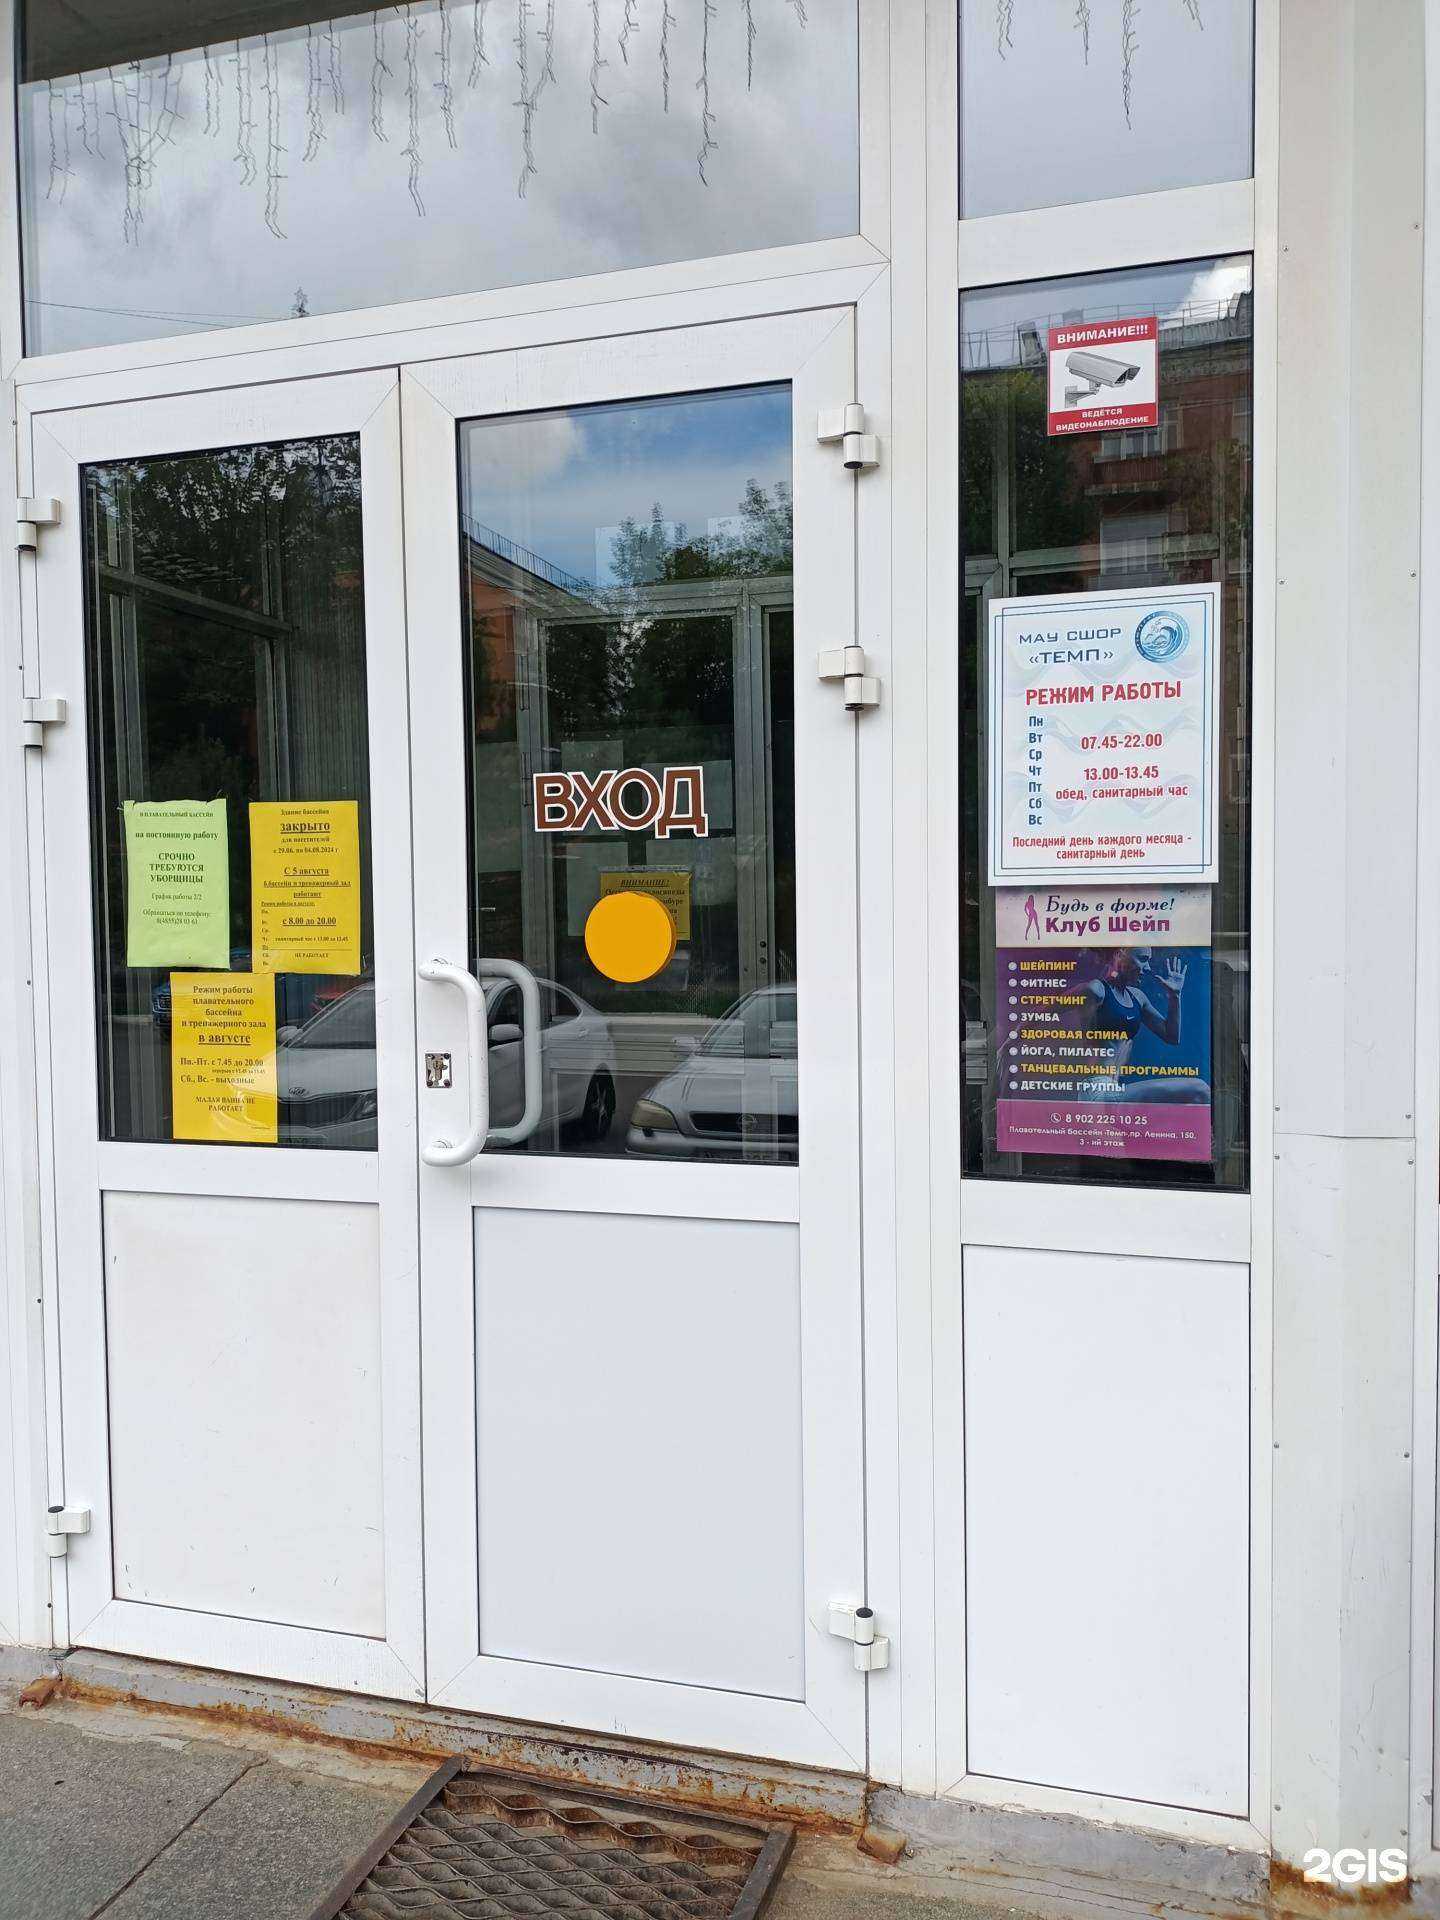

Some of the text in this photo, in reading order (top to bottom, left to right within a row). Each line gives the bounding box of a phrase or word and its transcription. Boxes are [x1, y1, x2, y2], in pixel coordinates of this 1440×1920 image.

[1057, 324, 1148, 344] ВНИМАНИЕ!!!
[1056, 416, 1149, 432] ВИДЕОНАБЛЮДЕНИЕ
[1019, 628, 1122, 645] МАУ СШОР
[1029, 649, 1113, 665] «ТЕМП»
[1025, 681, 1182, 706] РЕЖИМ РАБОТЫ
[1029, 716, 1044, 727] Пн
[1029, 732, 1043, 744] Вт
[1081, 733, 1163, 750] 07.45-22.00
[1029, 749, 1042, 762] Ср
[1029, 765, 1042, 776] Чт
[1083, 765, 1159, 781] 13.00-13.45
[1029, 782, 1042, 793] Пт
[1055, 785, 1188, 801] обед, санитарный час
[533, 766, 708, 839] ВХОД
[1029, 798, 1042, 809] Сб
[1029, 814, 1043, 826] Вс
[280, 822, 330, 834] закрыто
[146, 832, 191, 840] постоянную
[193, 831, 219, 841] работу
[1012, 835, 1066, 848] Последний
[1069, 837, 1094, 848] день
[1098, 835, 1142, 847] каждого
[1146, 835, 1184, 846] месяца
[158, 852, 195, 862] СРОЧНО
[1056, 848, 1145, 861] санитарный день
[149, 863, 204, 872] ТРЕБУЮТСЯ
[284, 867, 329, 876] С 5 августа
[150, 874, 203, 884] УБОРЩИЦЫ
[1045, 895, 1175, 915] Будь в форме!
[288, 917, 304, 925] 8.00
[305, 918, 315, 926] до
[316, 917, 337, 925] 20.00
[1045, 915, 1170, 937] Клуб Шейп
[1020, 960, 1077, 972] ШЕЙПИНГ
[1020, 978, 1067, 988] ФИТНЕС
[193, 986, 253, 995] Режим работы
[1020, 995, 1087, 1006] СТРЕТЧИНГ
[205, 1008, 242, 1016] бассейна
[1020, 1012, 1060, 1023] ЗУМБА
[189, 1020, 247, 1029] тренажерного
[198, 1034, 251, 1043] в августе
[1020, 1030, 1128, 1041] ЗДОРОВАЯ СПИНА
[1021, 1046, 1115, 1058] ЙОГА, ПИЛАТЕС
[180, 1057, 210, 1066] Пн.-Пт.
[217, 1058, 232, 1066] 7.45
[244, 1058, 264, 1067] 20.00
[1020, 1063, 1199, 1077] ТАНЦЕВАЛЬНЫЕ ПРОГРАММЫ
[197, 1075, 209, 1083] Вс.
[1020, 1081, 1126, 1093] ДЕТСКИЕ ГРУППЫ
[208, 1104, 243, 1112] РАБОТАЕТ
[1065, 1114, 1148, 1126] 8 902 225 10 25
[1009, 1126, 1065, 1135] Плавательный
[1068, 1127, 1103, 1136] бассейн
